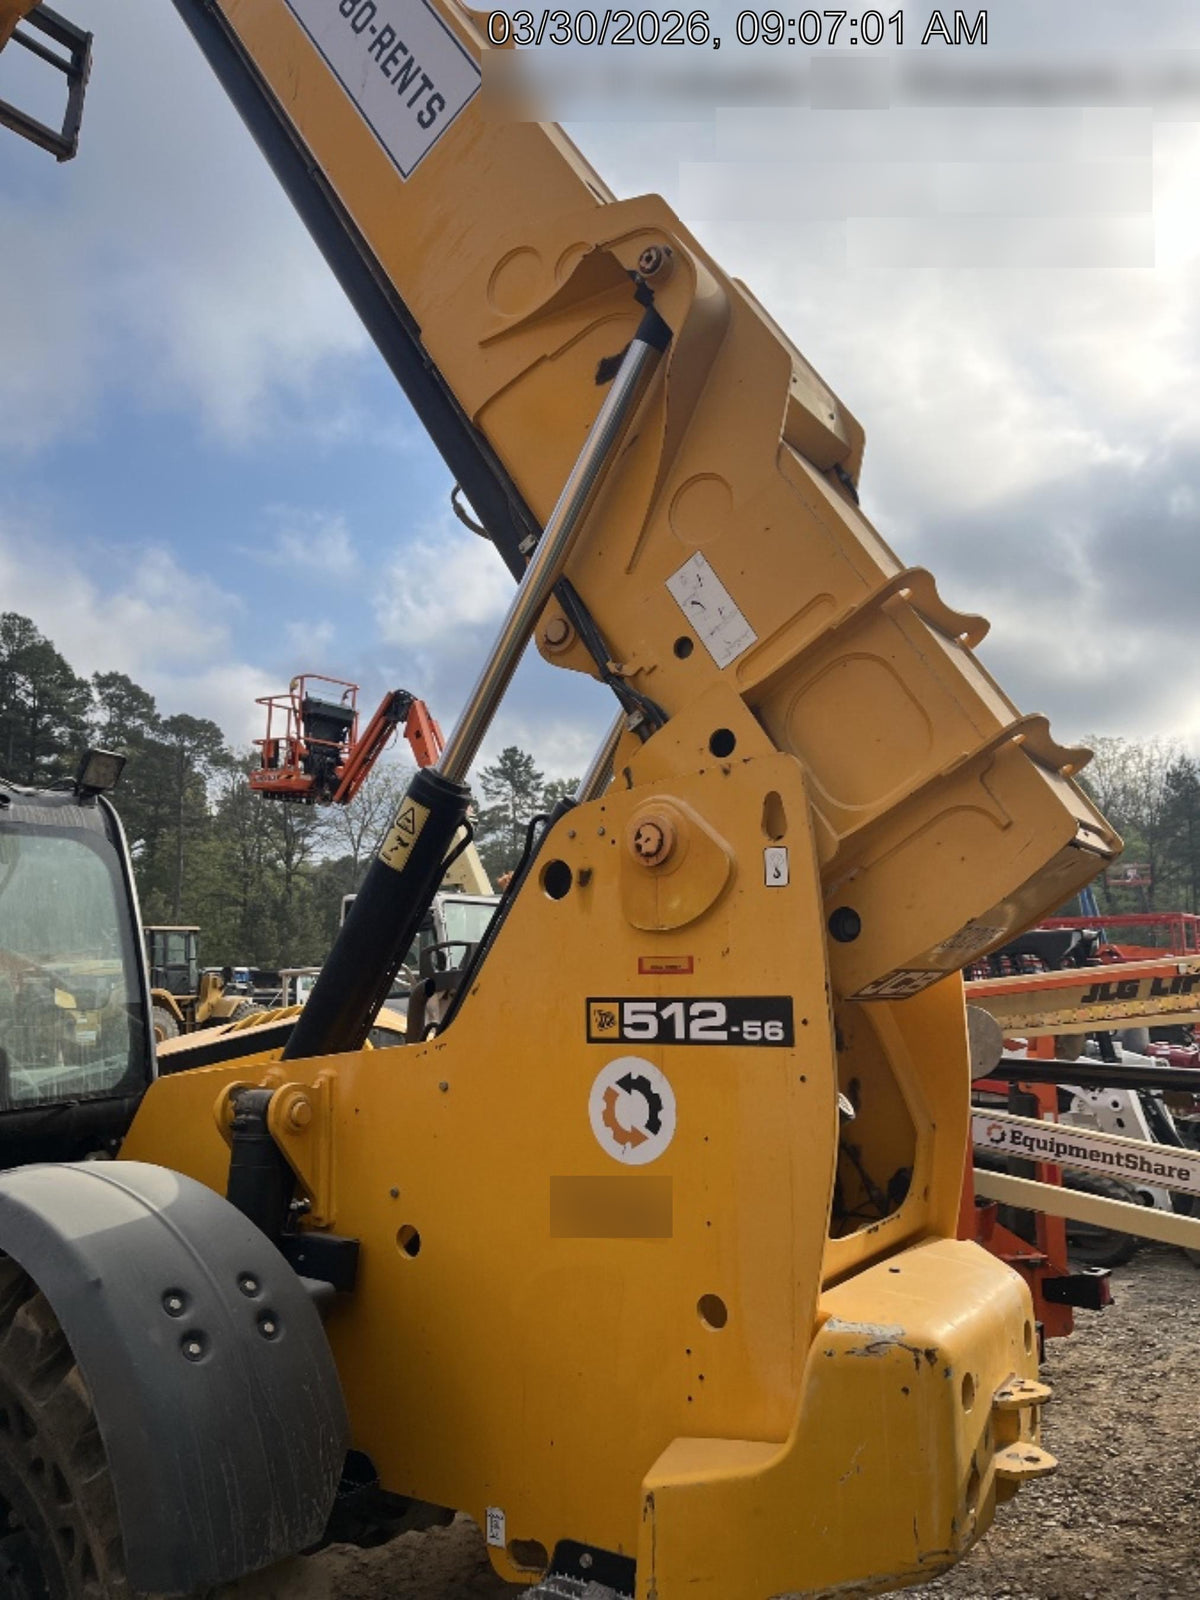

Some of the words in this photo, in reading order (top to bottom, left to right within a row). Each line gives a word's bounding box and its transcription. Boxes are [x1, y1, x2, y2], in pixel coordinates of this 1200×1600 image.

[1081, 979, 1140, 1003] JLG
[623, 1002, 785, 1041] 512-56
[1009, 1129, 1190, 1181] EquipmentShare
